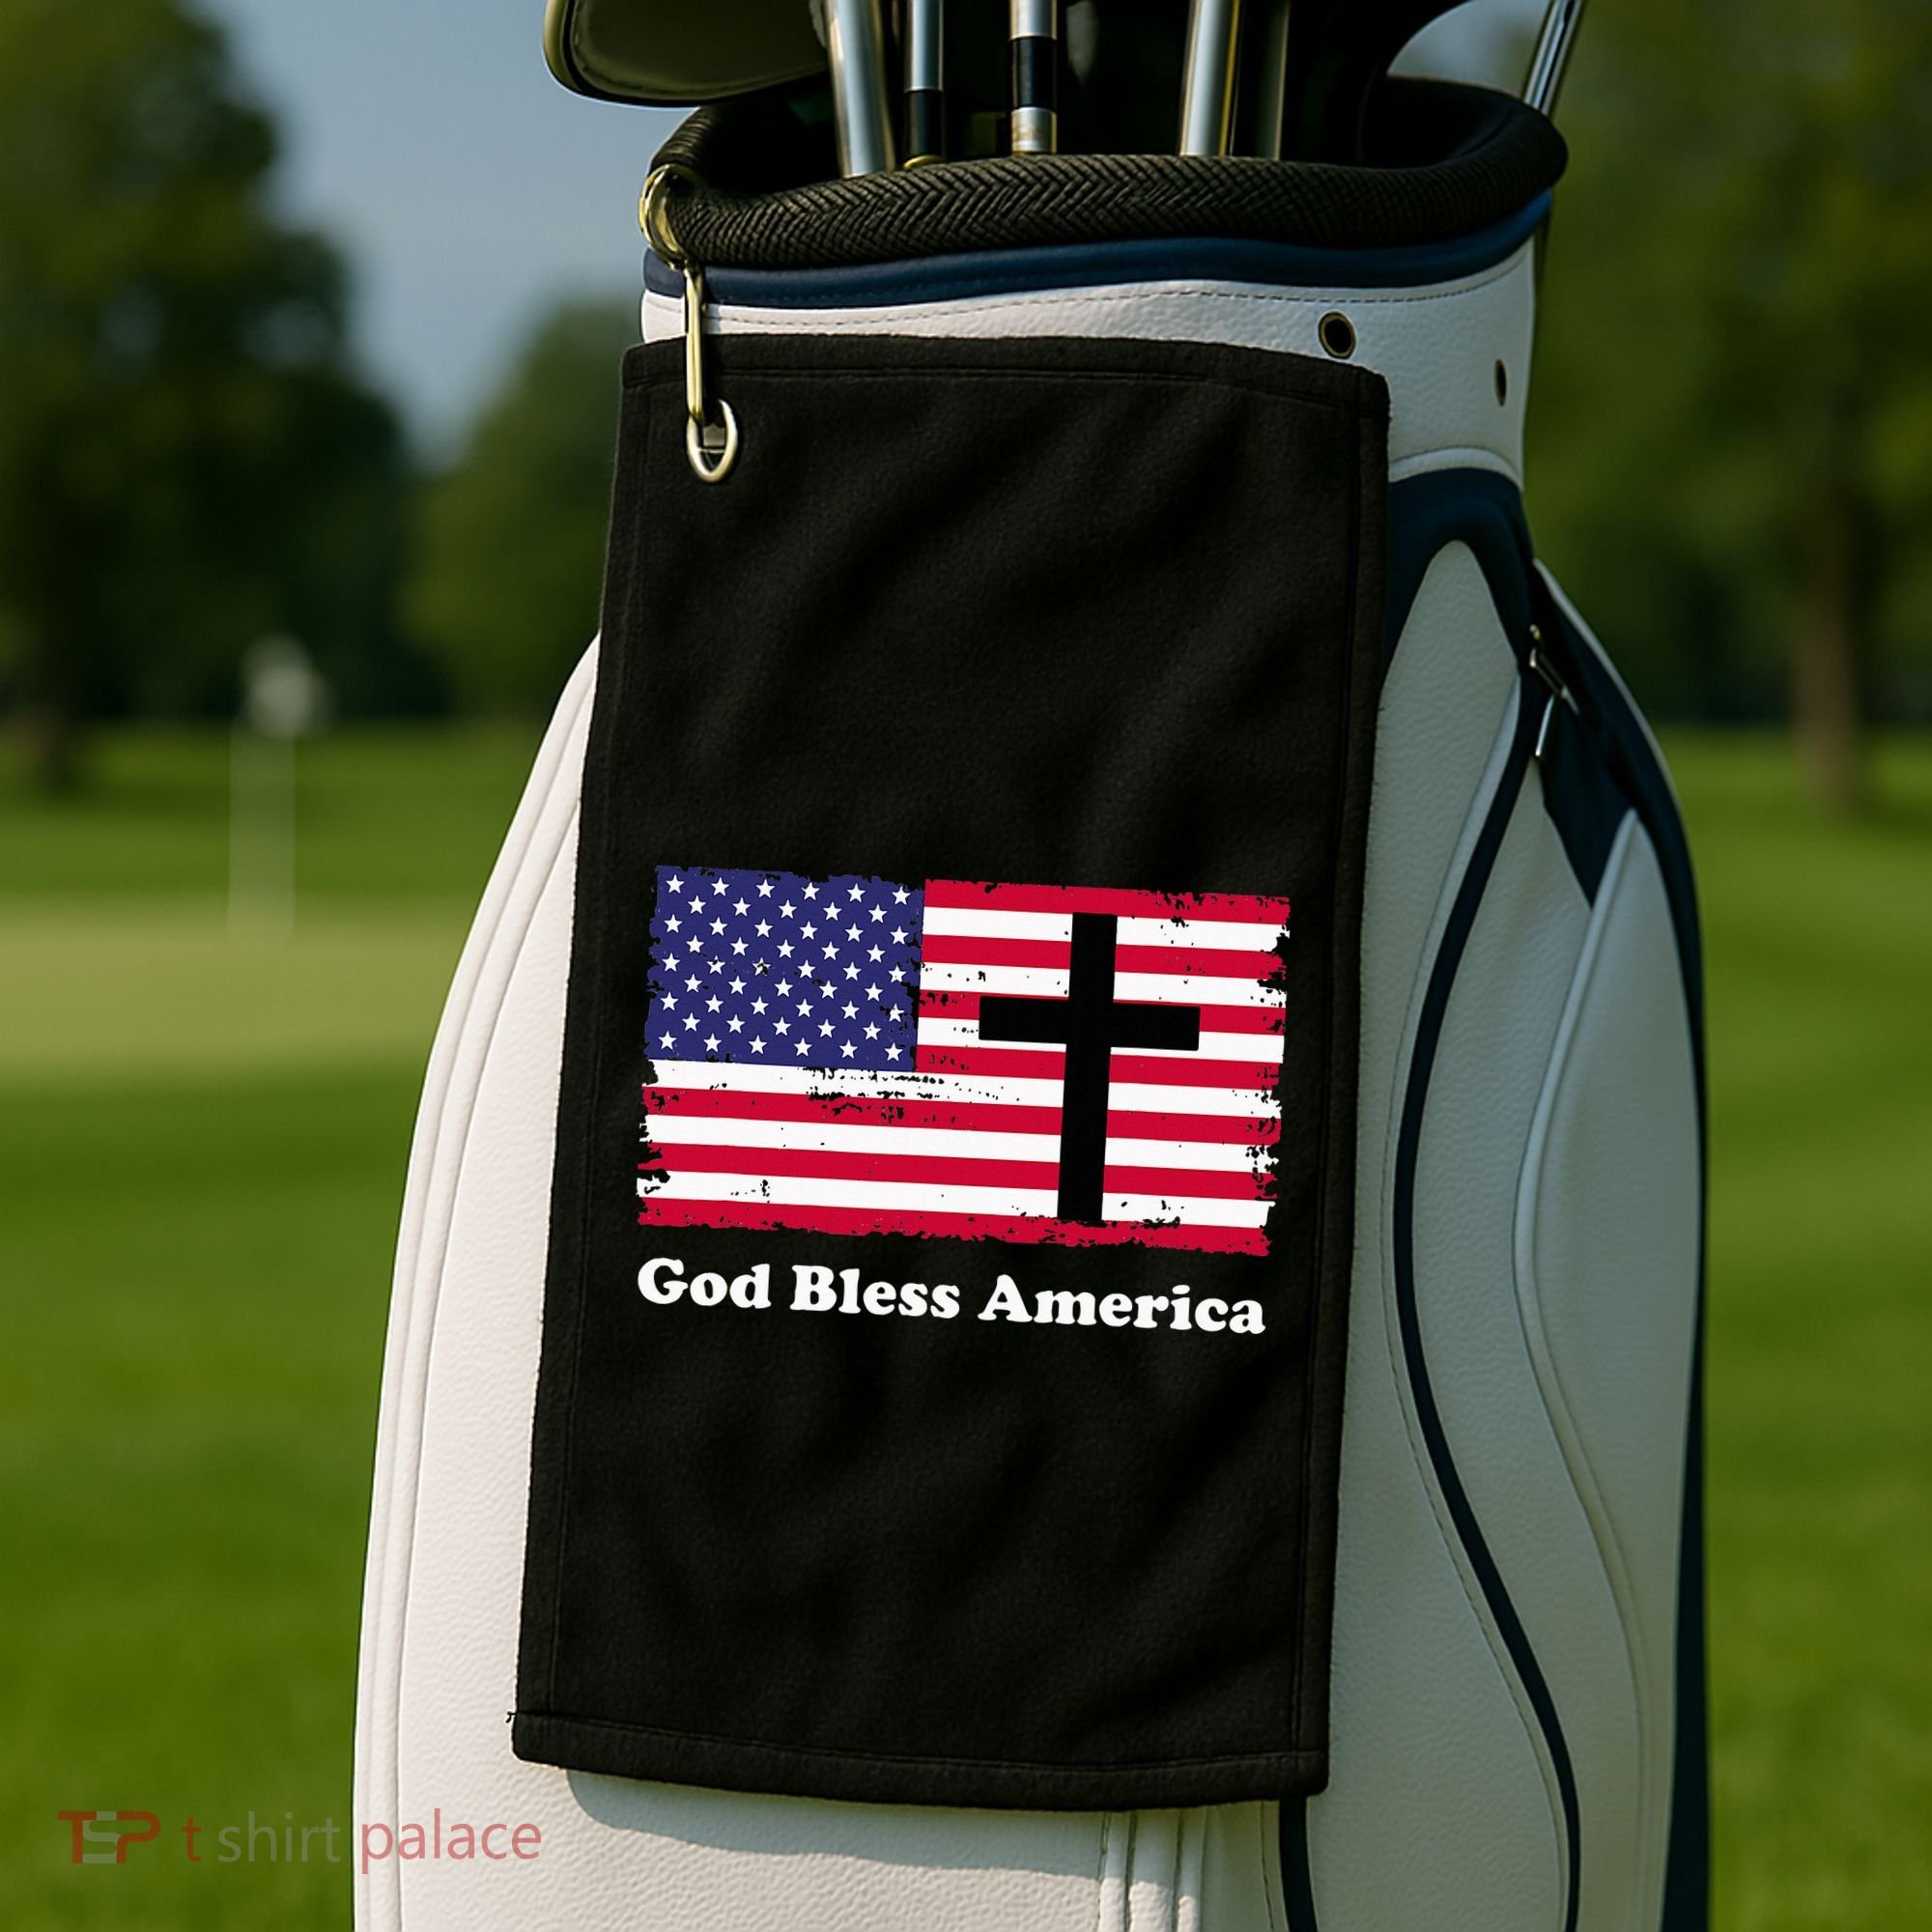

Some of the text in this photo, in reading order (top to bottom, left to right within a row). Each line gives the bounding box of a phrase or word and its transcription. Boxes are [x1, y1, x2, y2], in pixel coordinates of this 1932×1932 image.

[637, 1256, 1266, 1335] God Bless America
